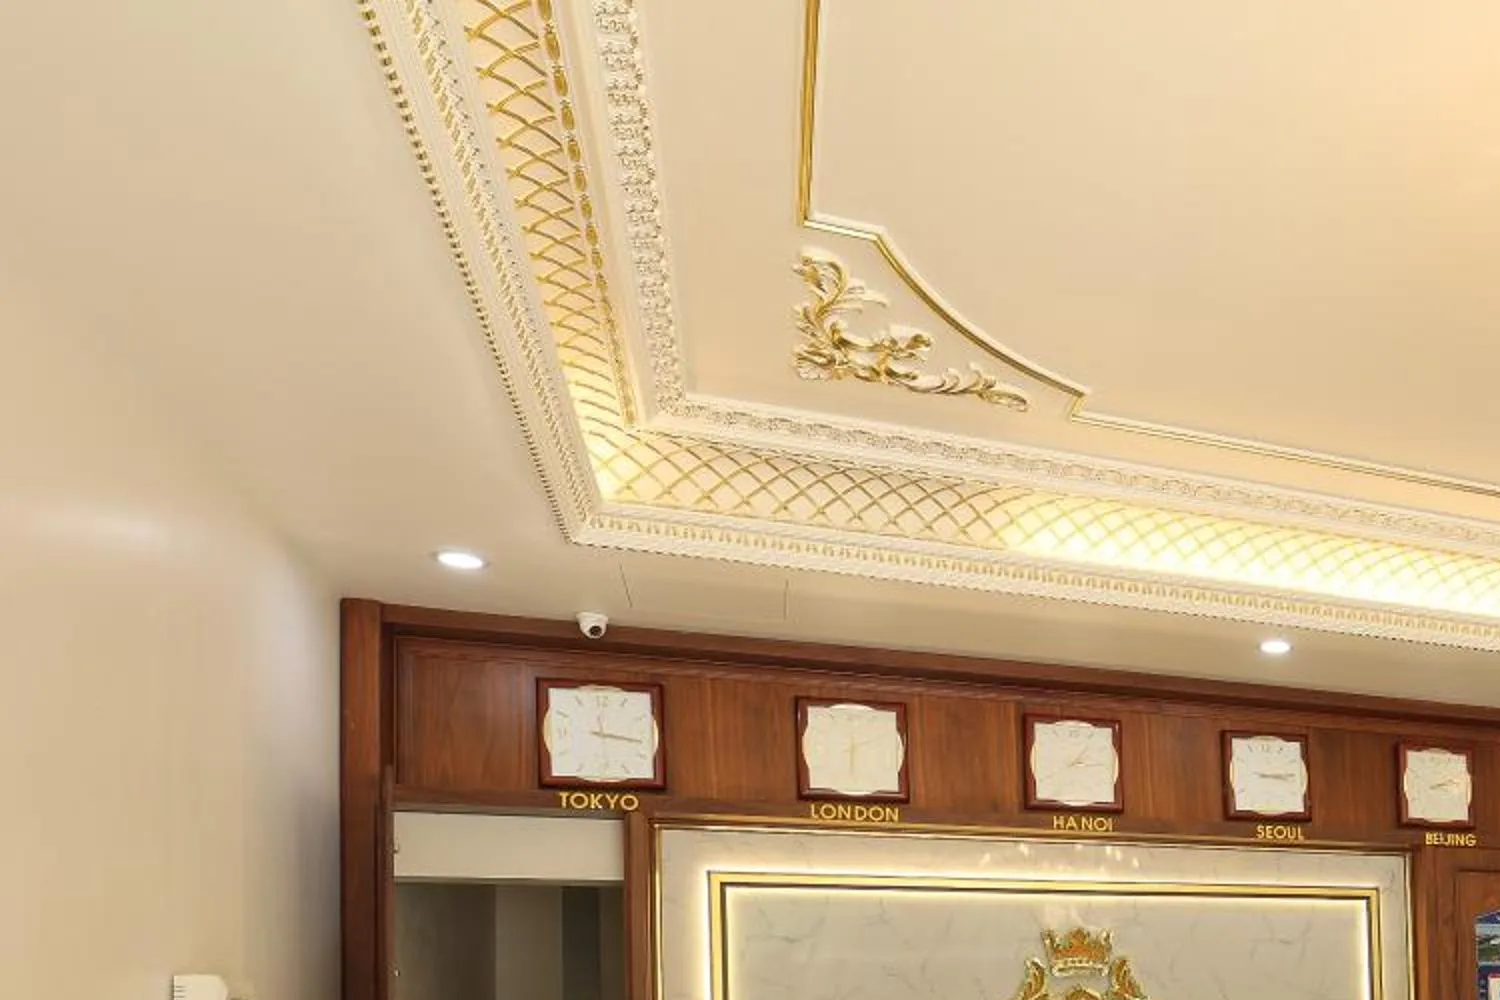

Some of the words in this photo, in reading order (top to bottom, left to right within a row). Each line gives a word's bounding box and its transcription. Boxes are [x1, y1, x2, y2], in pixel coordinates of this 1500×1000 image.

[559, 791, 639, 811] TOKYO
[810, 803, 899, 822] LONDON
[1256, 825, 1305, 840] SEOUL
